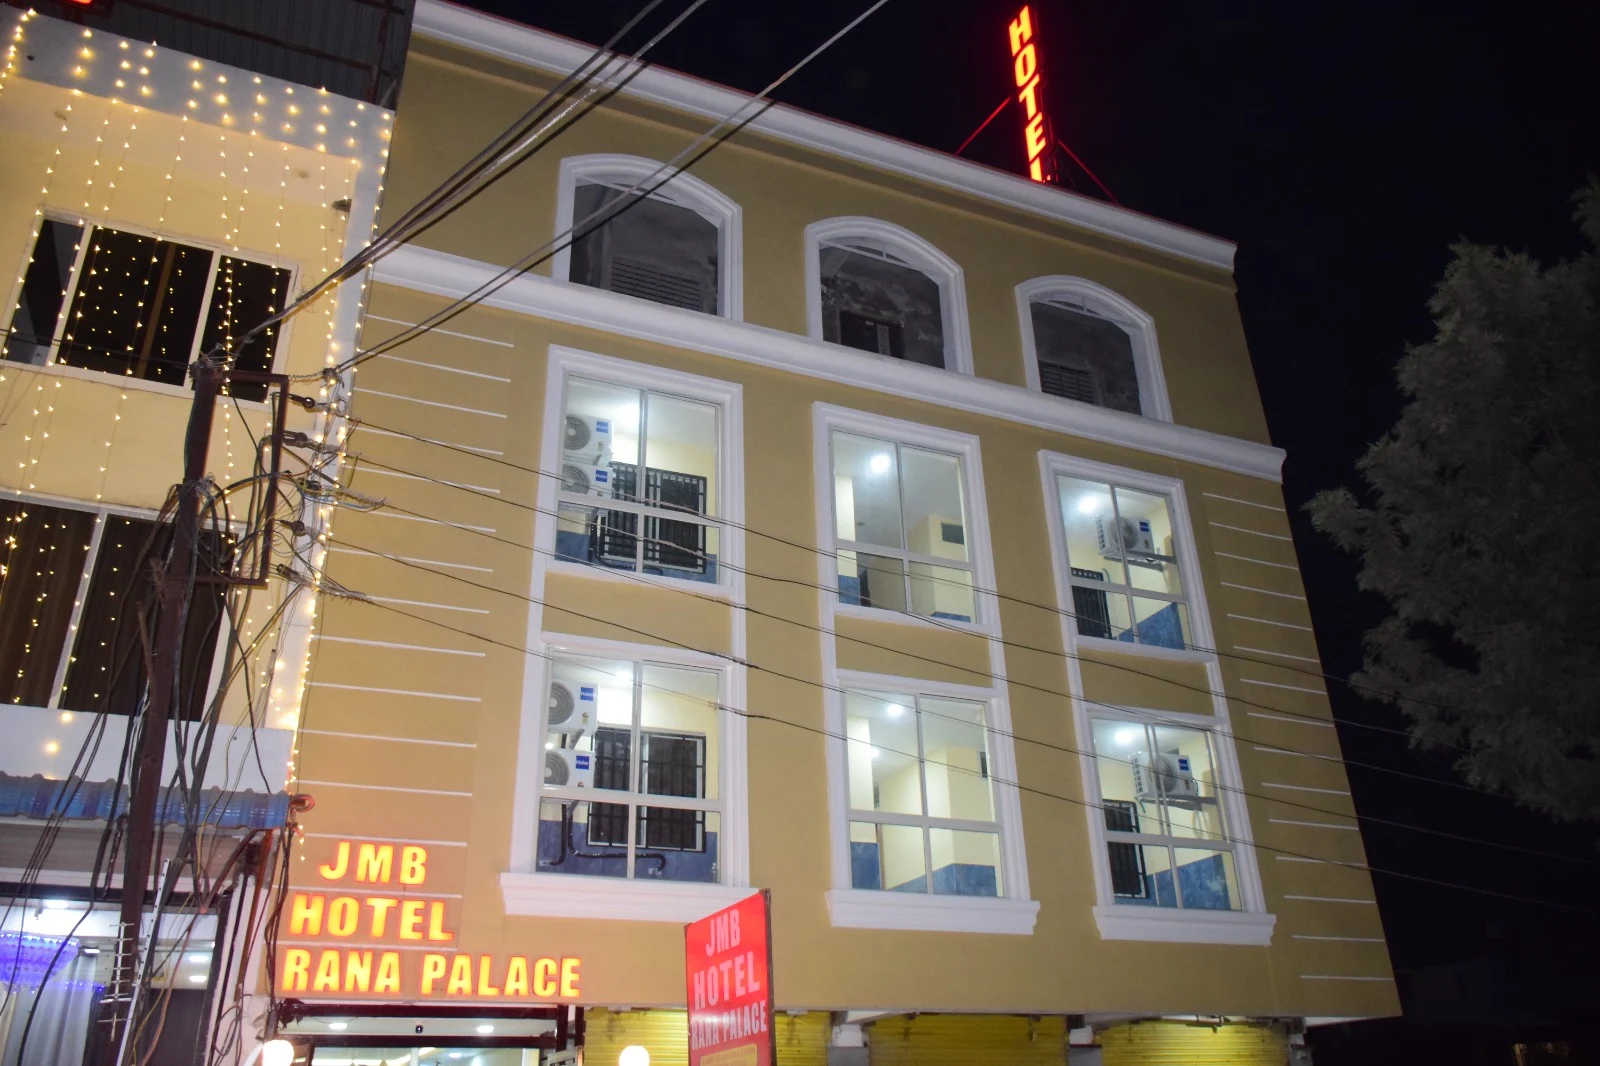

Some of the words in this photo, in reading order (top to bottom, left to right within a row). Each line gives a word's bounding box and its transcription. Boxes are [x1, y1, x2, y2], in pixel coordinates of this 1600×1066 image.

[319, 841, 427, 885] JMB
[289, 893, 455, 941] HOTEL
[705, 908, 741, 957] JMB
[281, 949, 401, 994] RANA
[420, 954, 582, 998] PALACE
[693, 951, 760, 1011] HOTEL
[691, 1015, 719, 1050] RANA
[723, 1000, 767, 1042] PALACE
